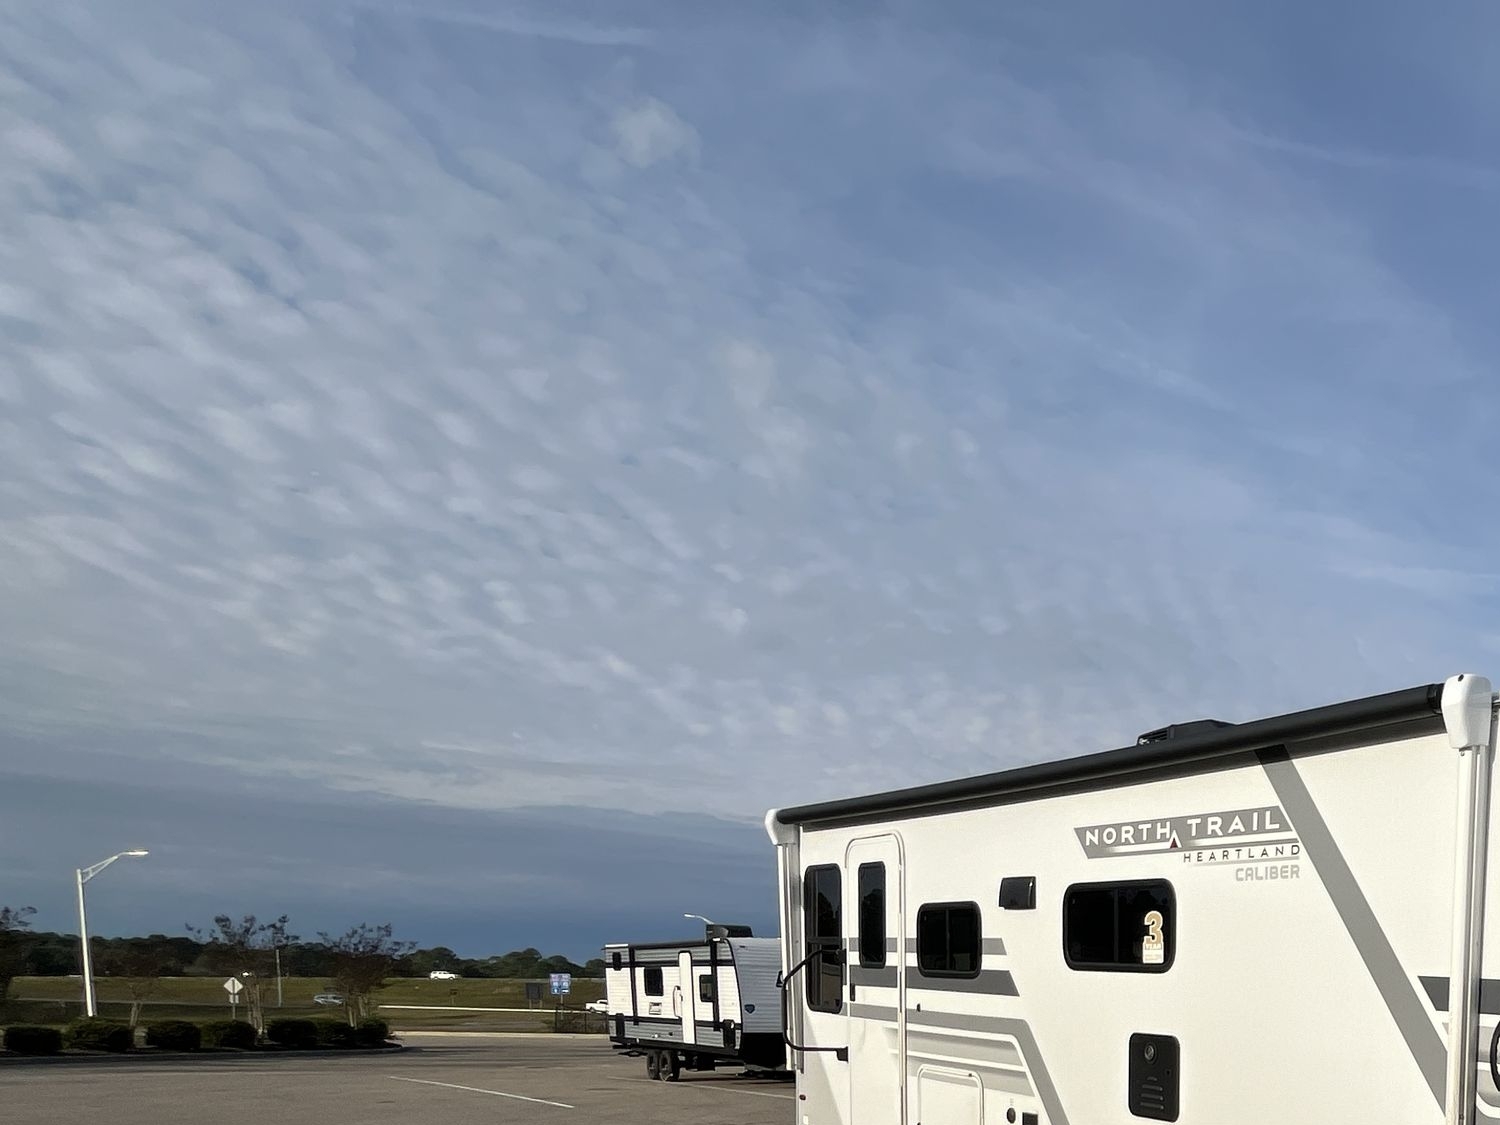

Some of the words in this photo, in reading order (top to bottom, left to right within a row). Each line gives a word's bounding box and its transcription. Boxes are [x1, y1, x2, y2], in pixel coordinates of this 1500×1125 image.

[1085, 821, 1171, 847] NORTH
[1186, 810, 1281, 837] TRAIL
[1183, 844, 1300, 863] HEARTLAND
[1235, 864, 1300, 882] CALIBER
[1144, 911, 1163, 943] 3
